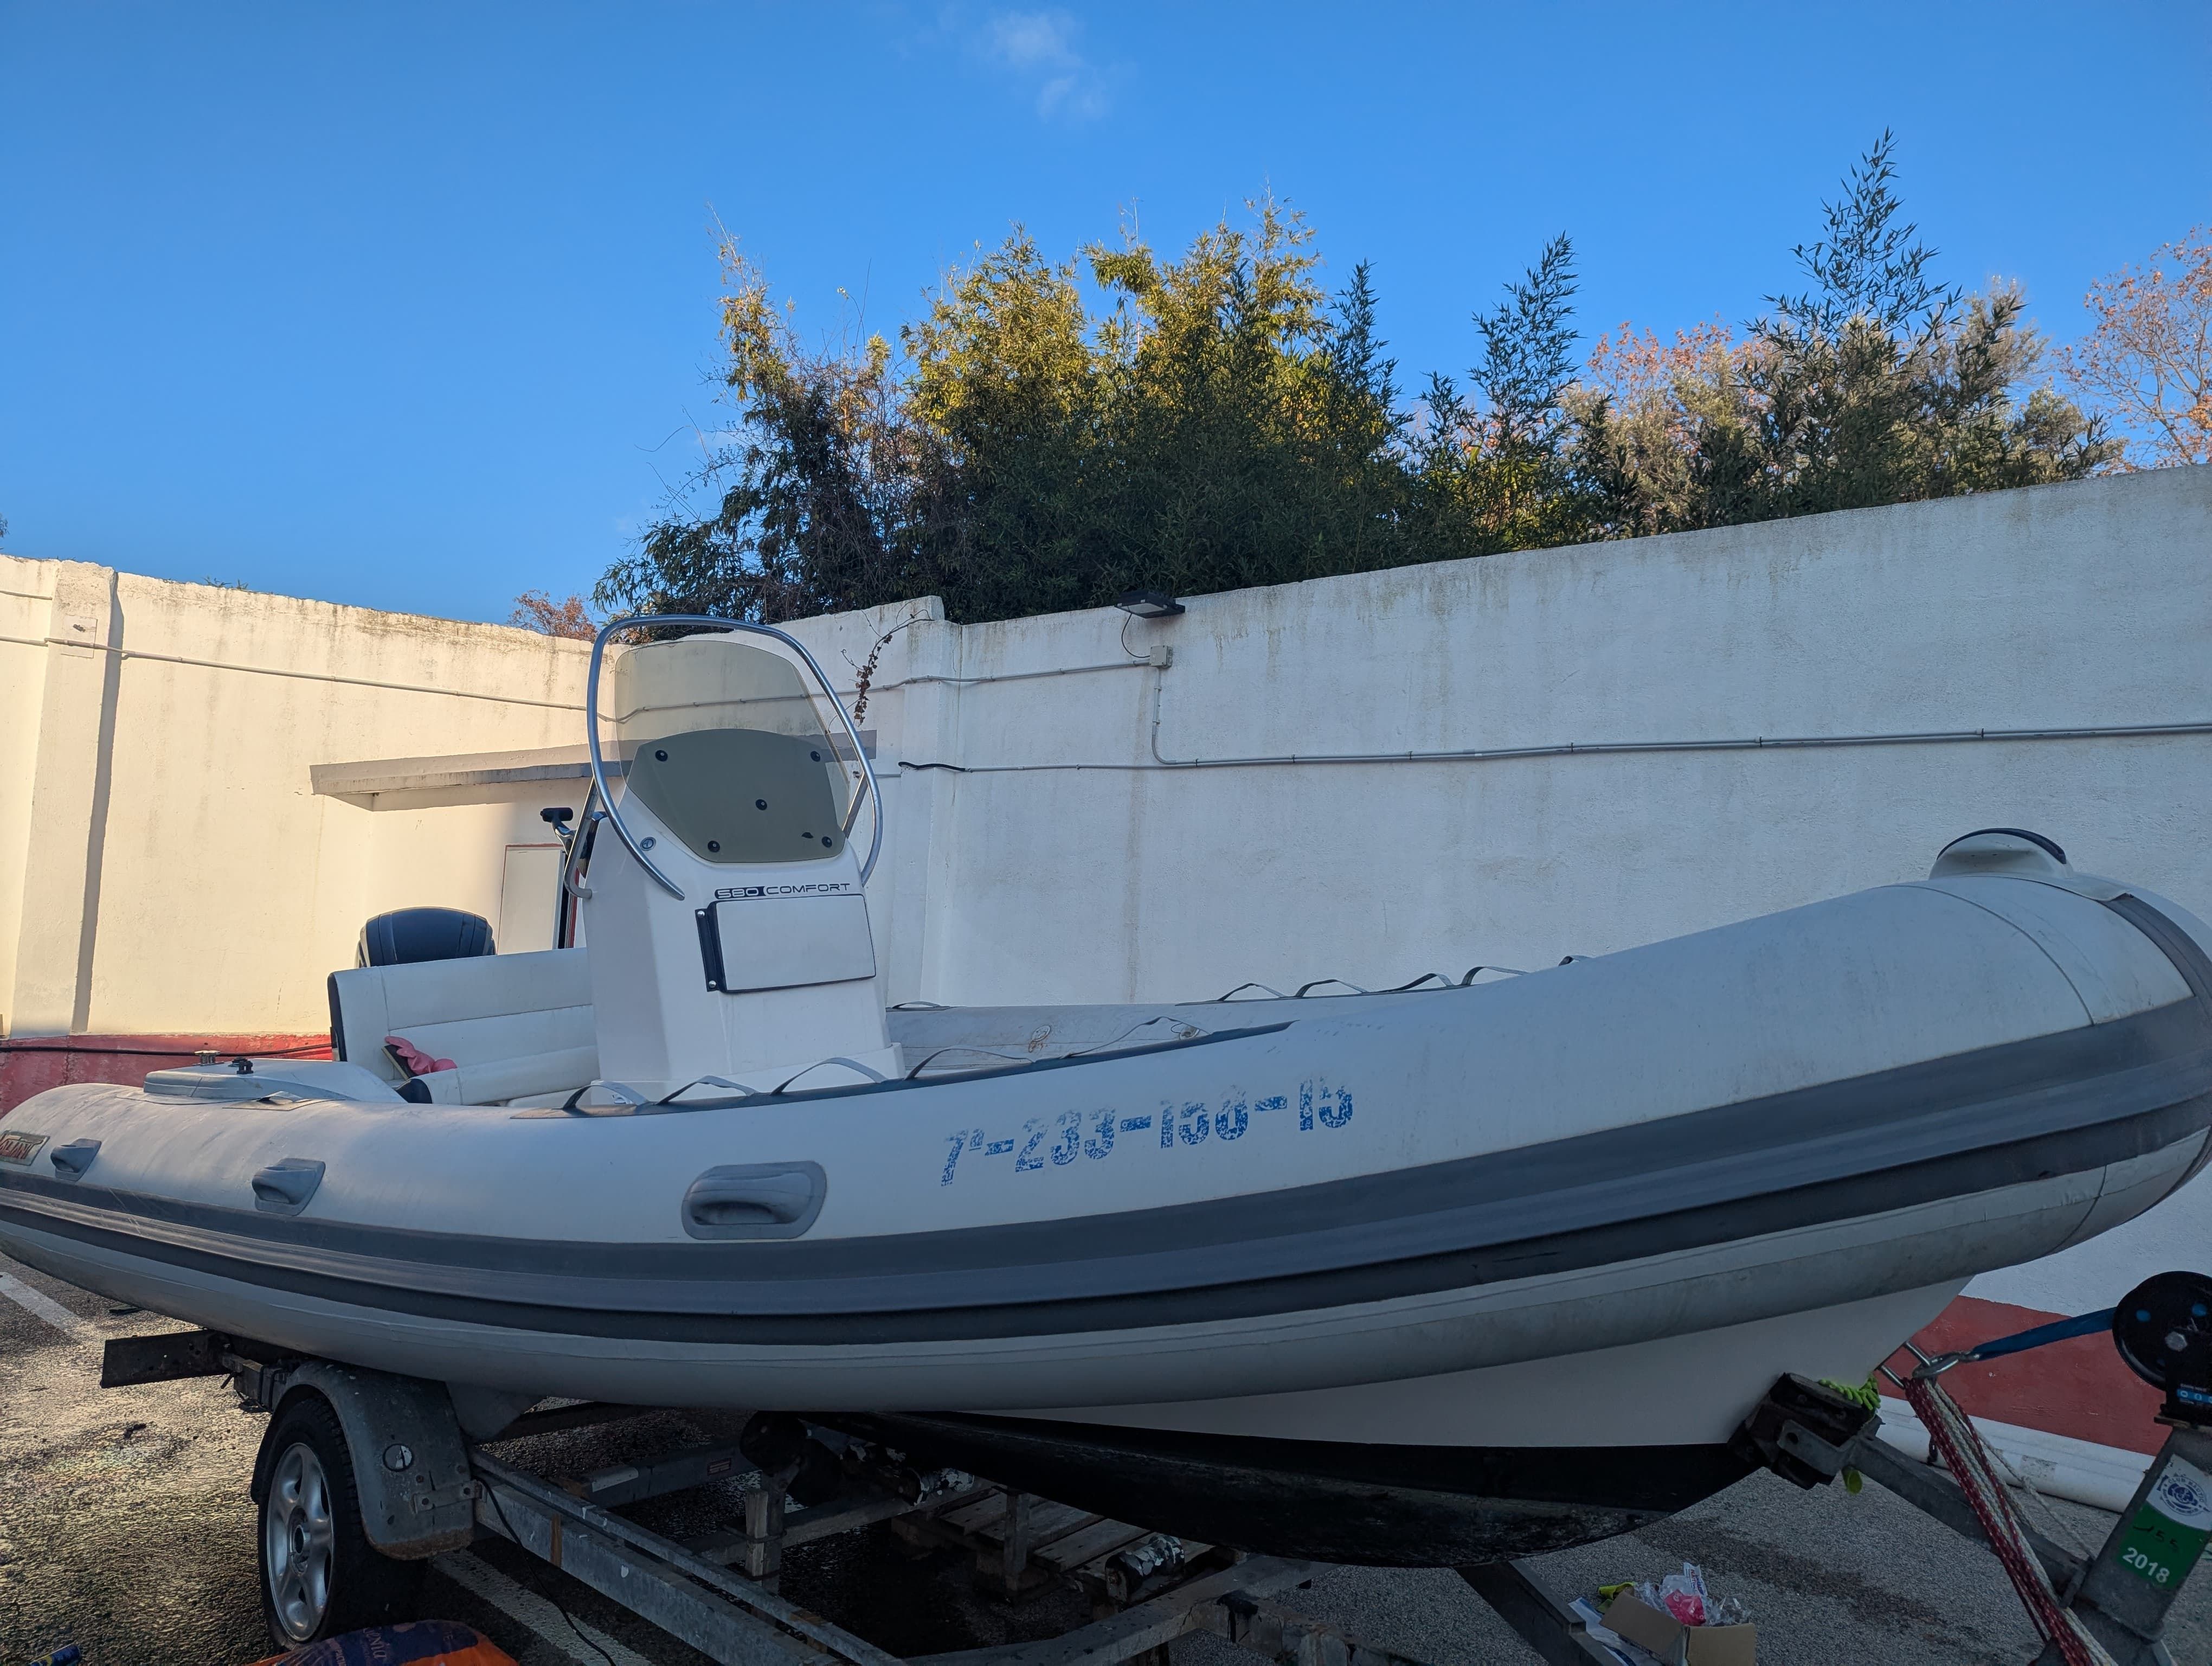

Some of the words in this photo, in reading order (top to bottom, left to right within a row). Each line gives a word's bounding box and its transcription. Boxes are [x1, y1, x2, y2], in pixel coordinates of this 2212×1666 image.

[717, 887, 759, 899] 580
[766, 883, 850, 895] COMFORT
[2122, 1547, 2171, 1584] 2018
